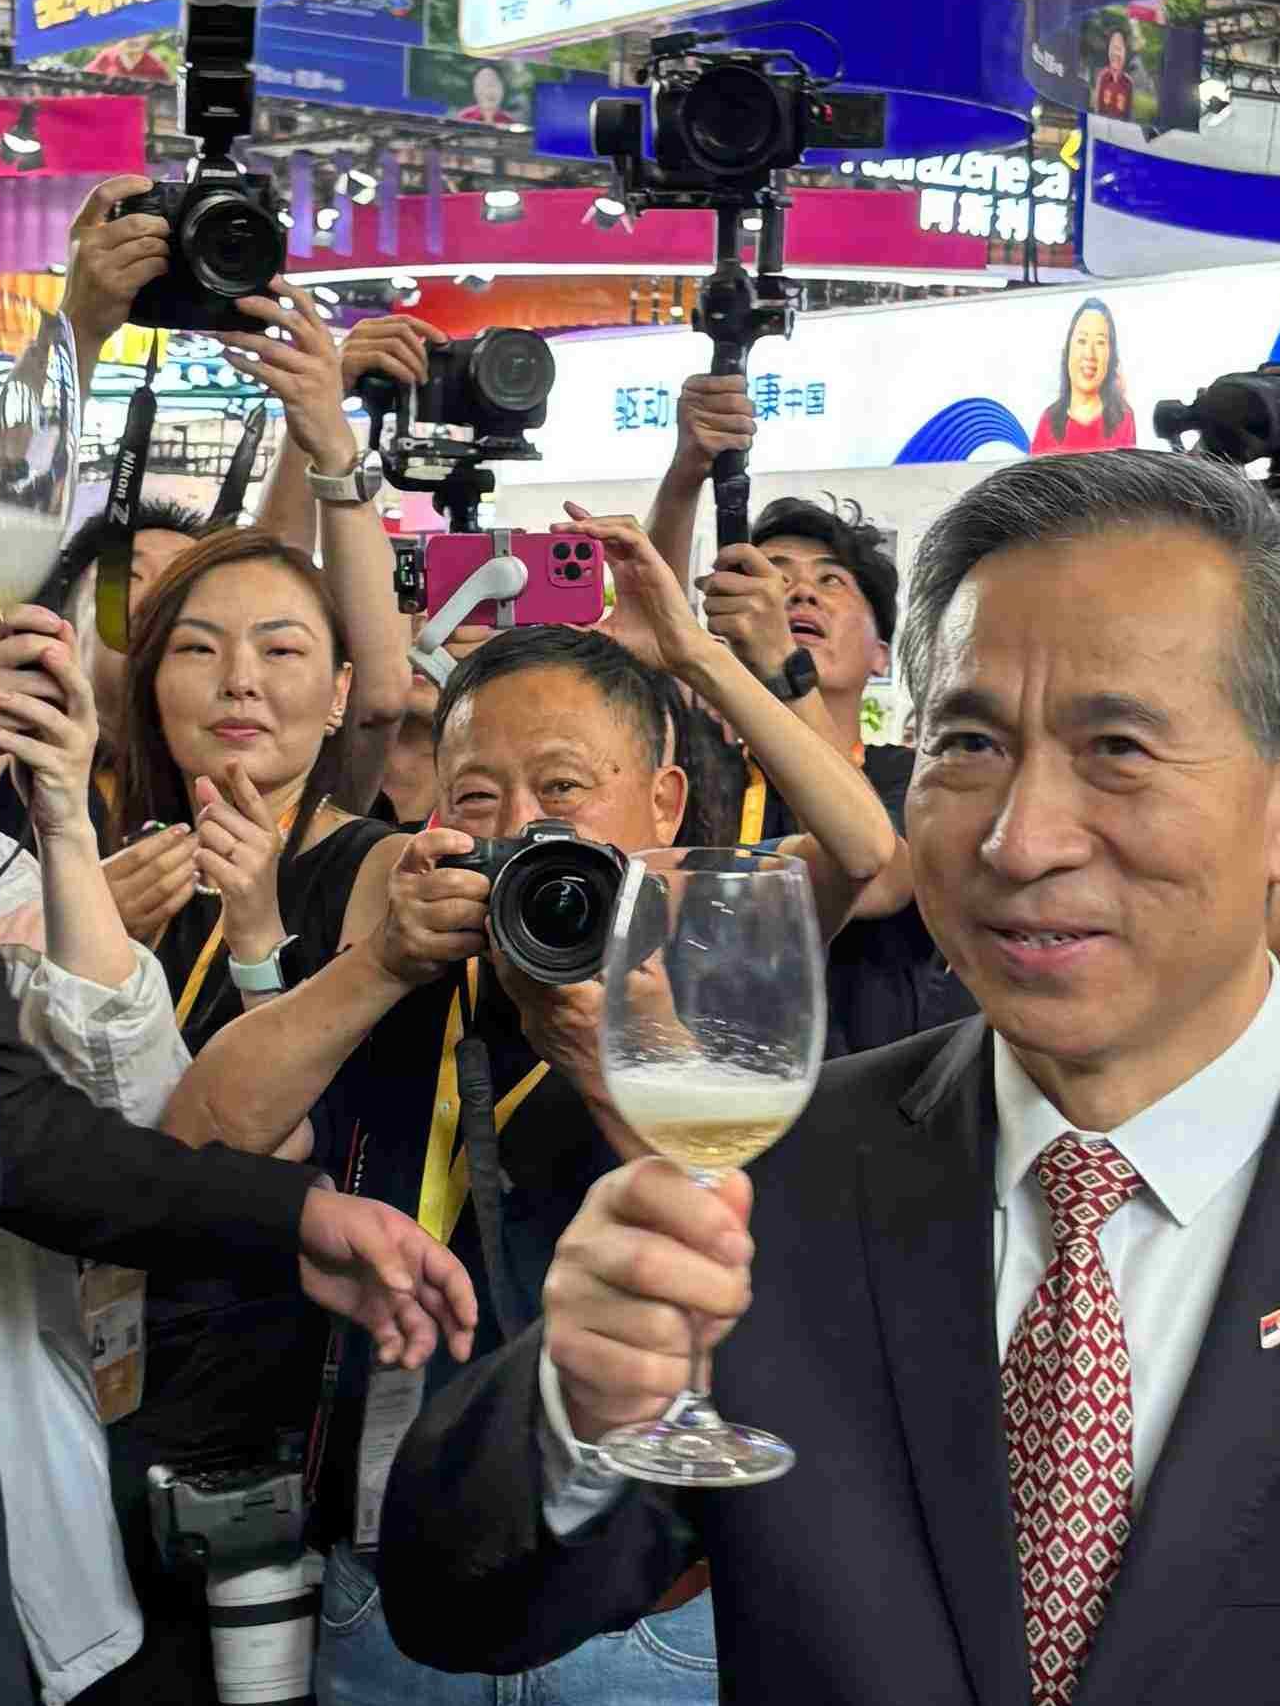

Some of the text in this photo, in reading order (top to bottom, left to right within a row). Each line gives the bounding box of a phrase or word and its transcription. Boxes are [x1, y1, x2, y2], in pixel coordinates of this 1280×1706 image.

[754, 373, 825, 421] 康中国
[116, 449, 137, 499] Nikon
